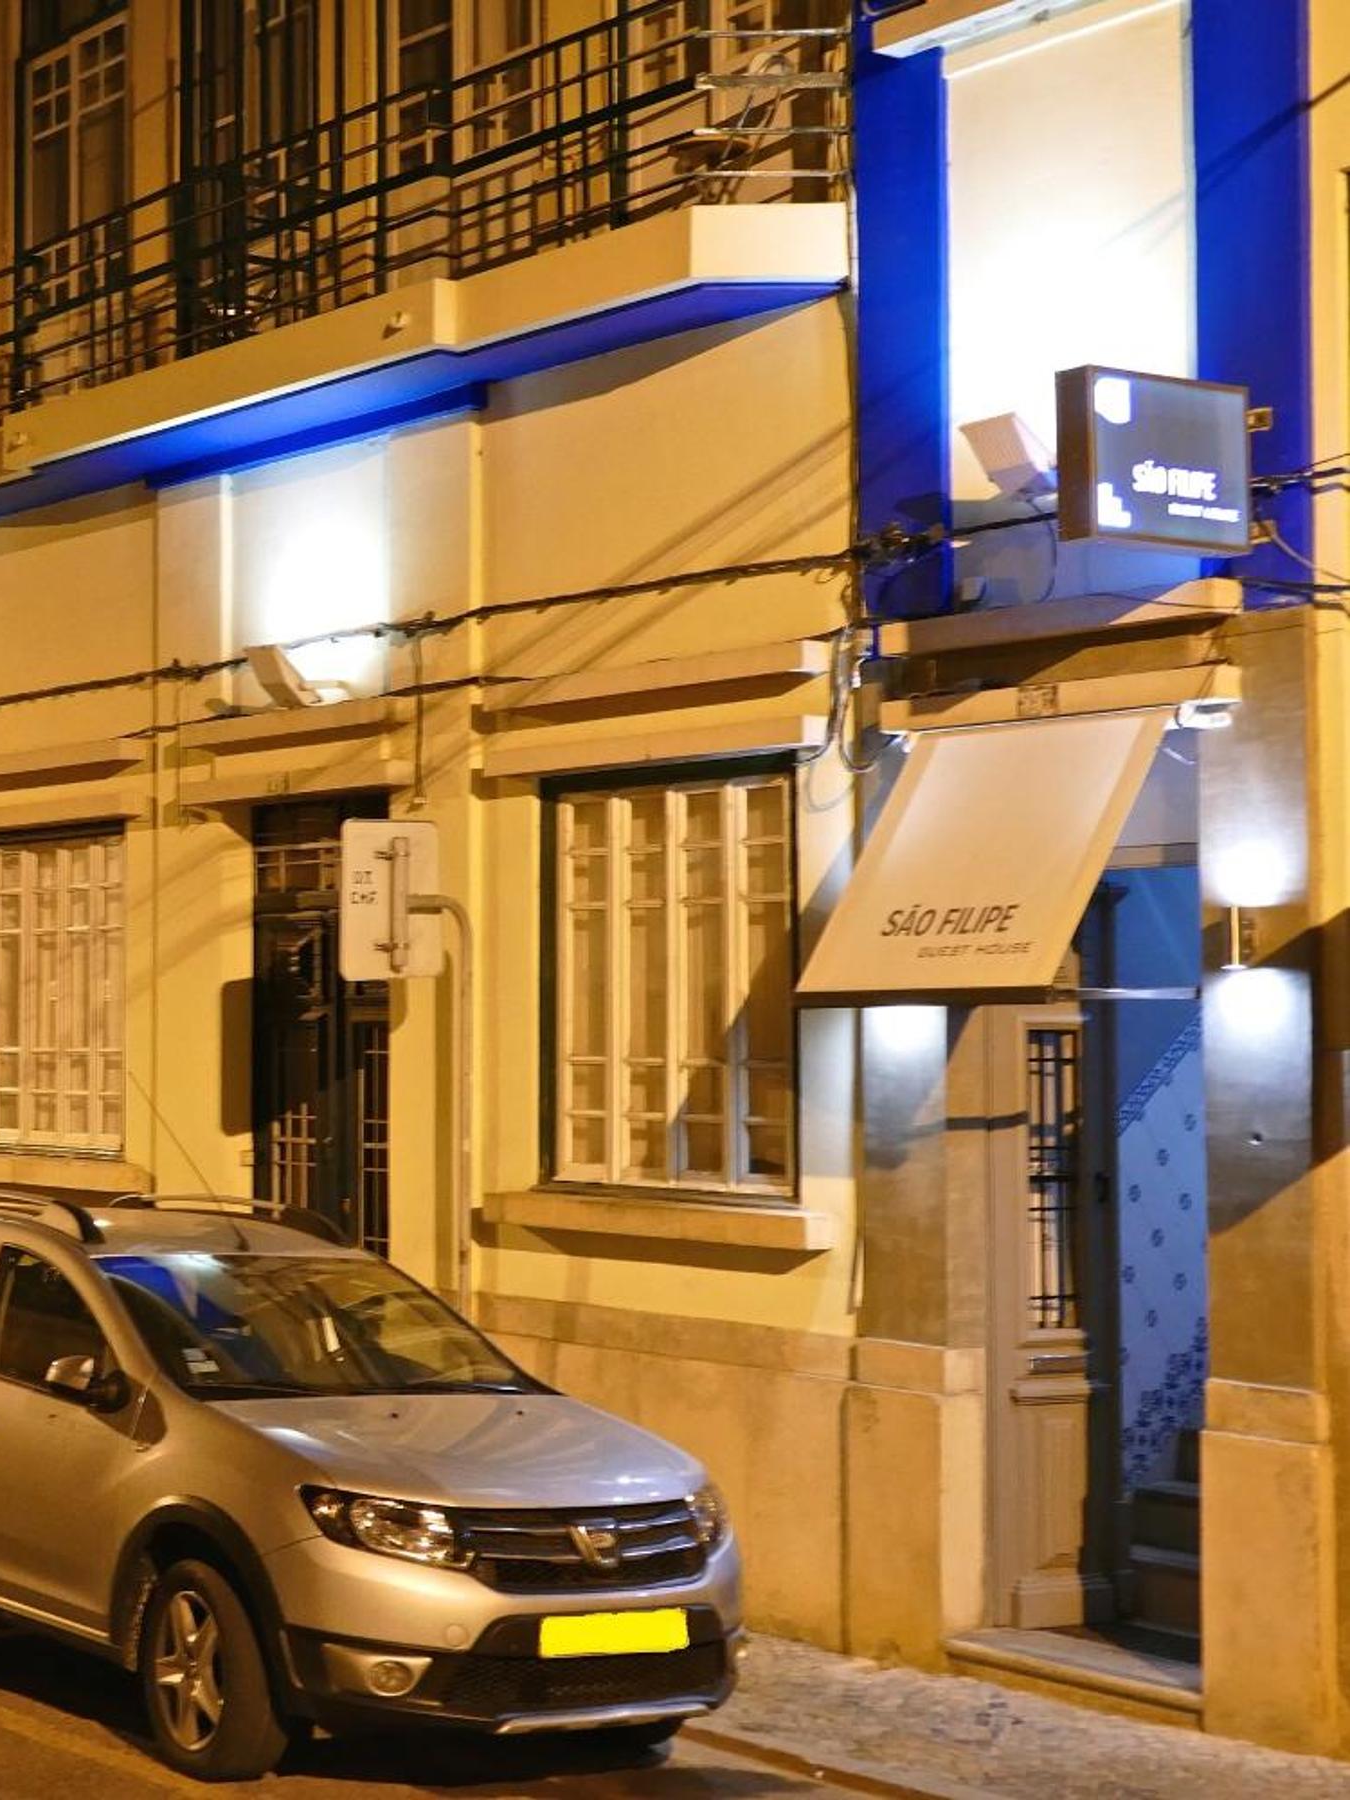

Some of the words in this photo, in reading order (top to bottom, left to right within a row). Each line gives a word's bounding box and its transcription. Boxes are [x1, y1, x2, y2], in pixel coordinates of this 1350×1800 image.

[881, 904, 937, 937] SÃO
[936, 904, 1020, 935] FILIPE
[916, 945, 973, 958] GUEST
[974, 941, 1034, 955] HOUSE
